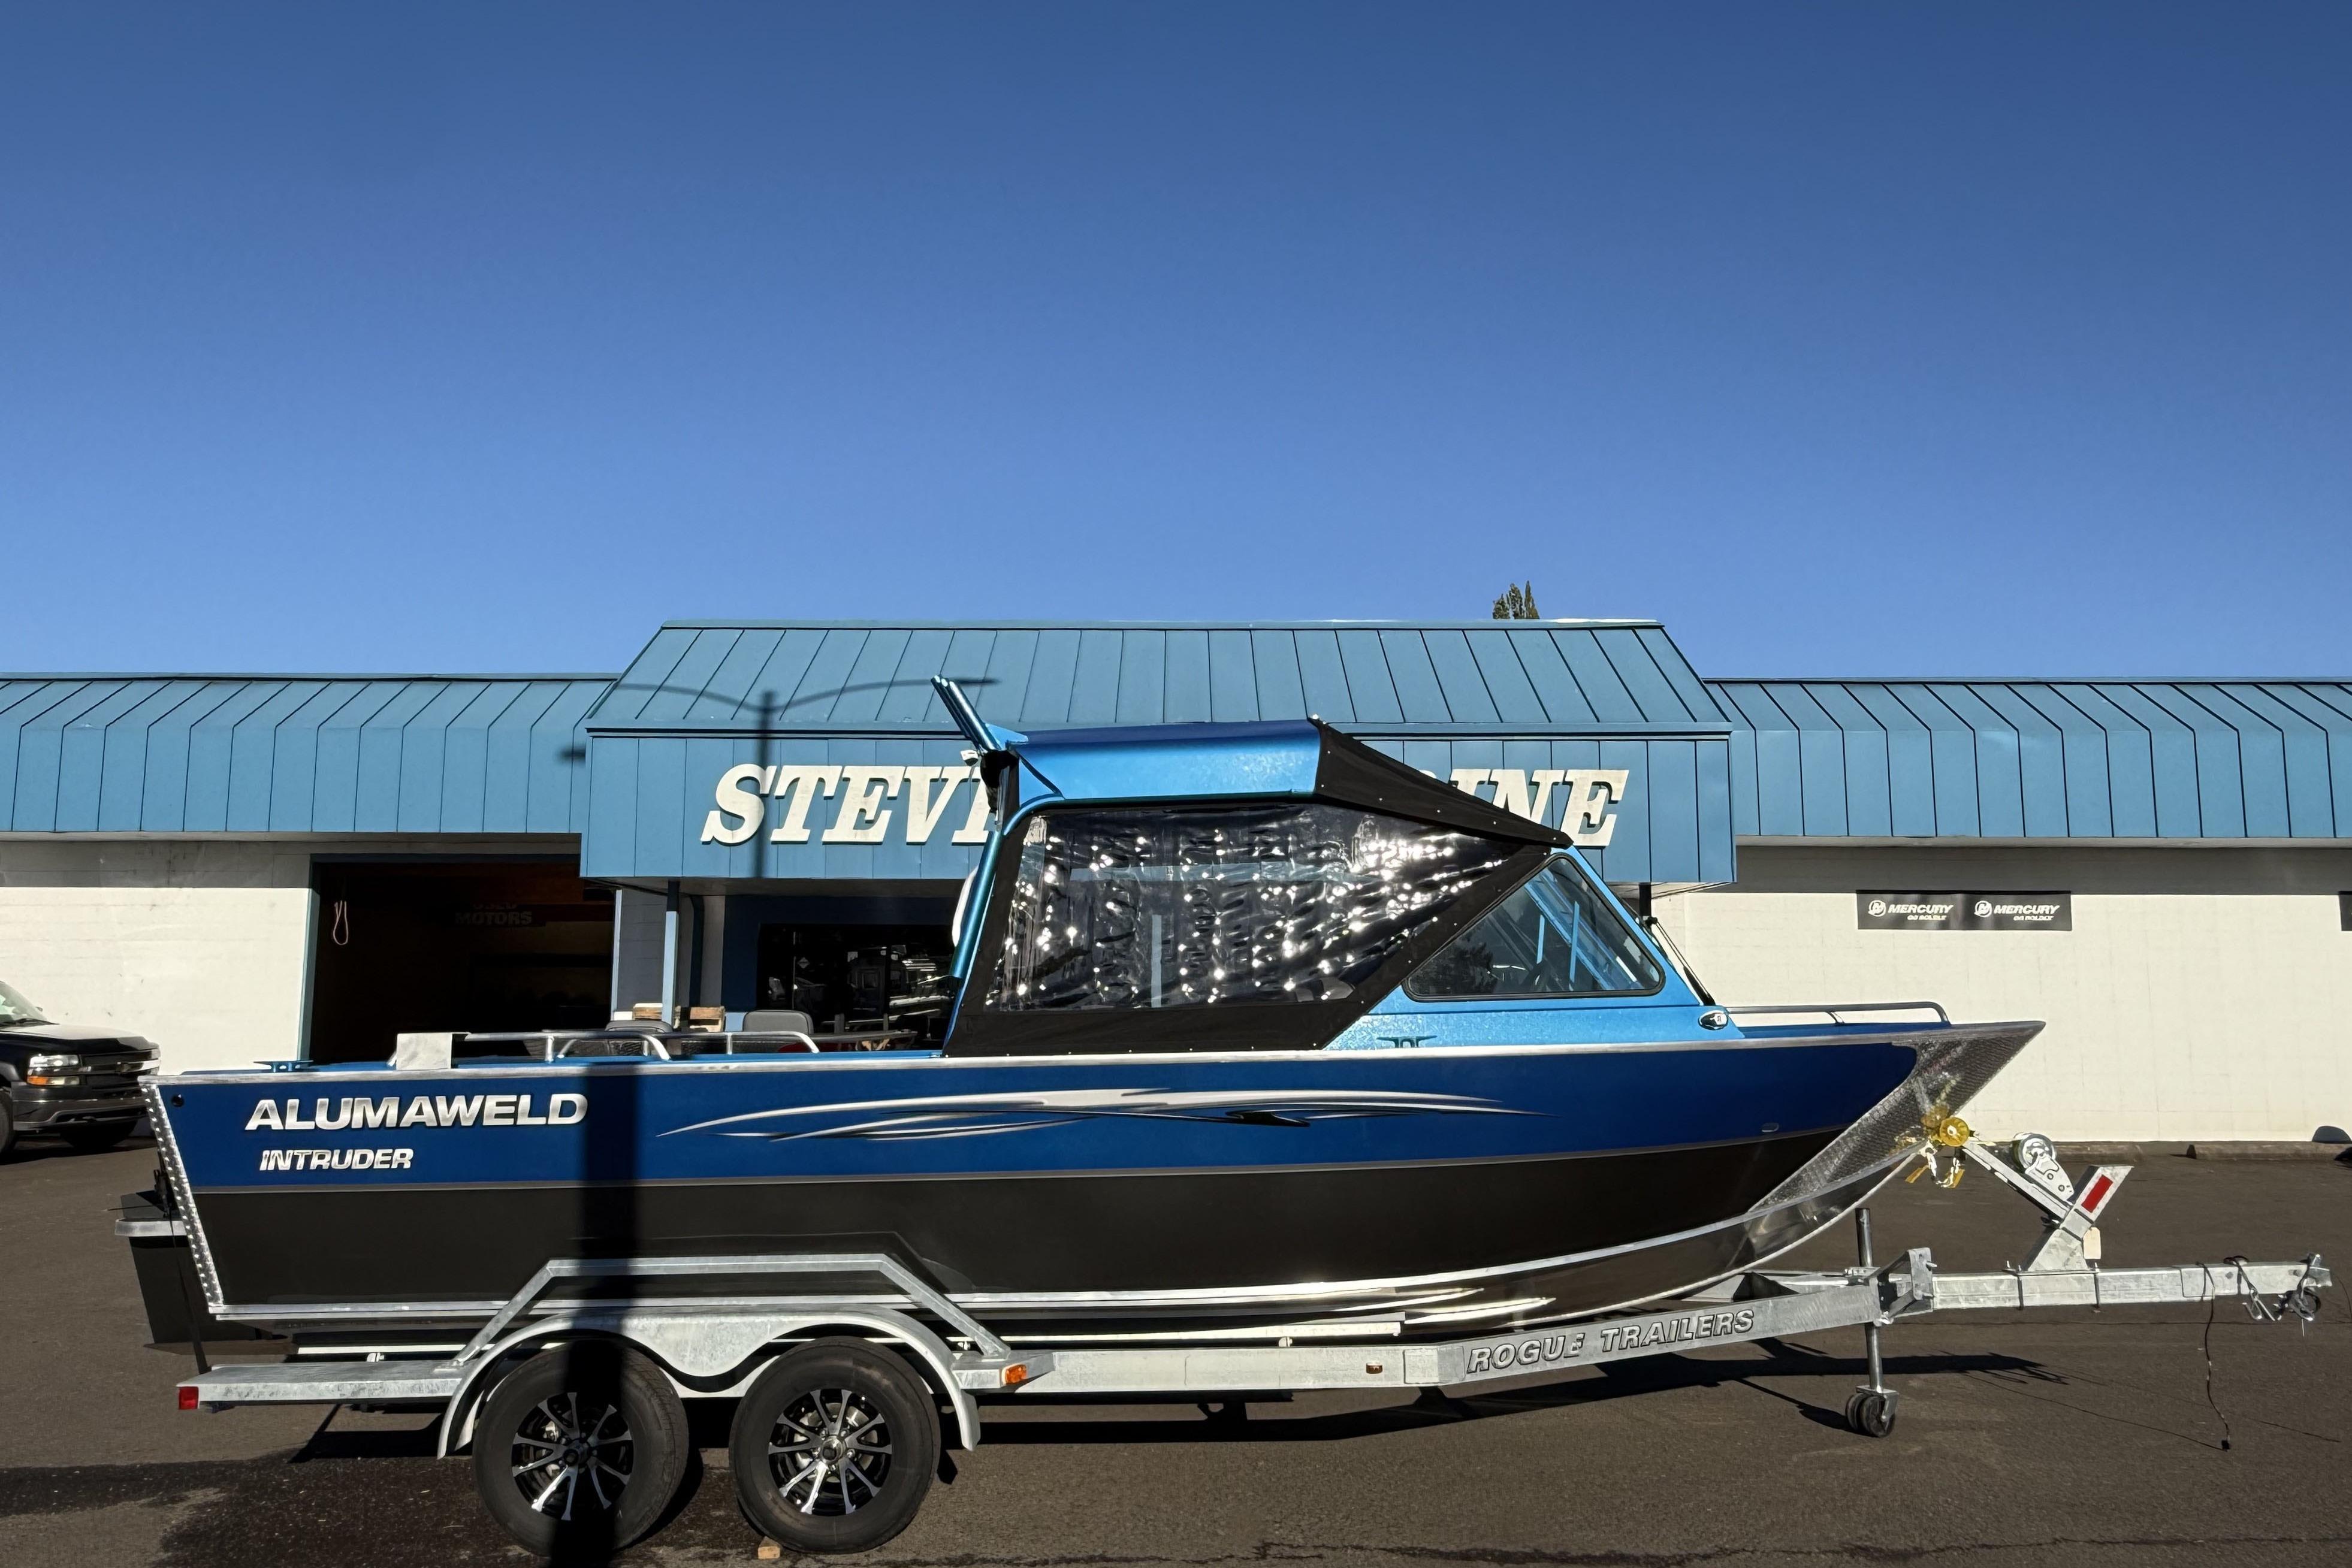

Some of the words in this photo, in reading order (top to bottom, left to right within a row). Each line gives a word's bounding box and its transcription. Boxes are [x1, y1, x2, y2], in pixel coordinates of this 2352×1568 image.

[455, 911, 533, 926] MOTORS
[1888, 904, 1954, 914] MERCURY
[1994, 905, 2060, 914] MERCURY
[245, 1093, 588, 1130] ALUMAWELD
[259, 1148, 413, 1171] INTRUDER
[1466, 1333, 1585, 1374] ROGUE
[1601, 1310, 1755, 1352] TRAILERS
